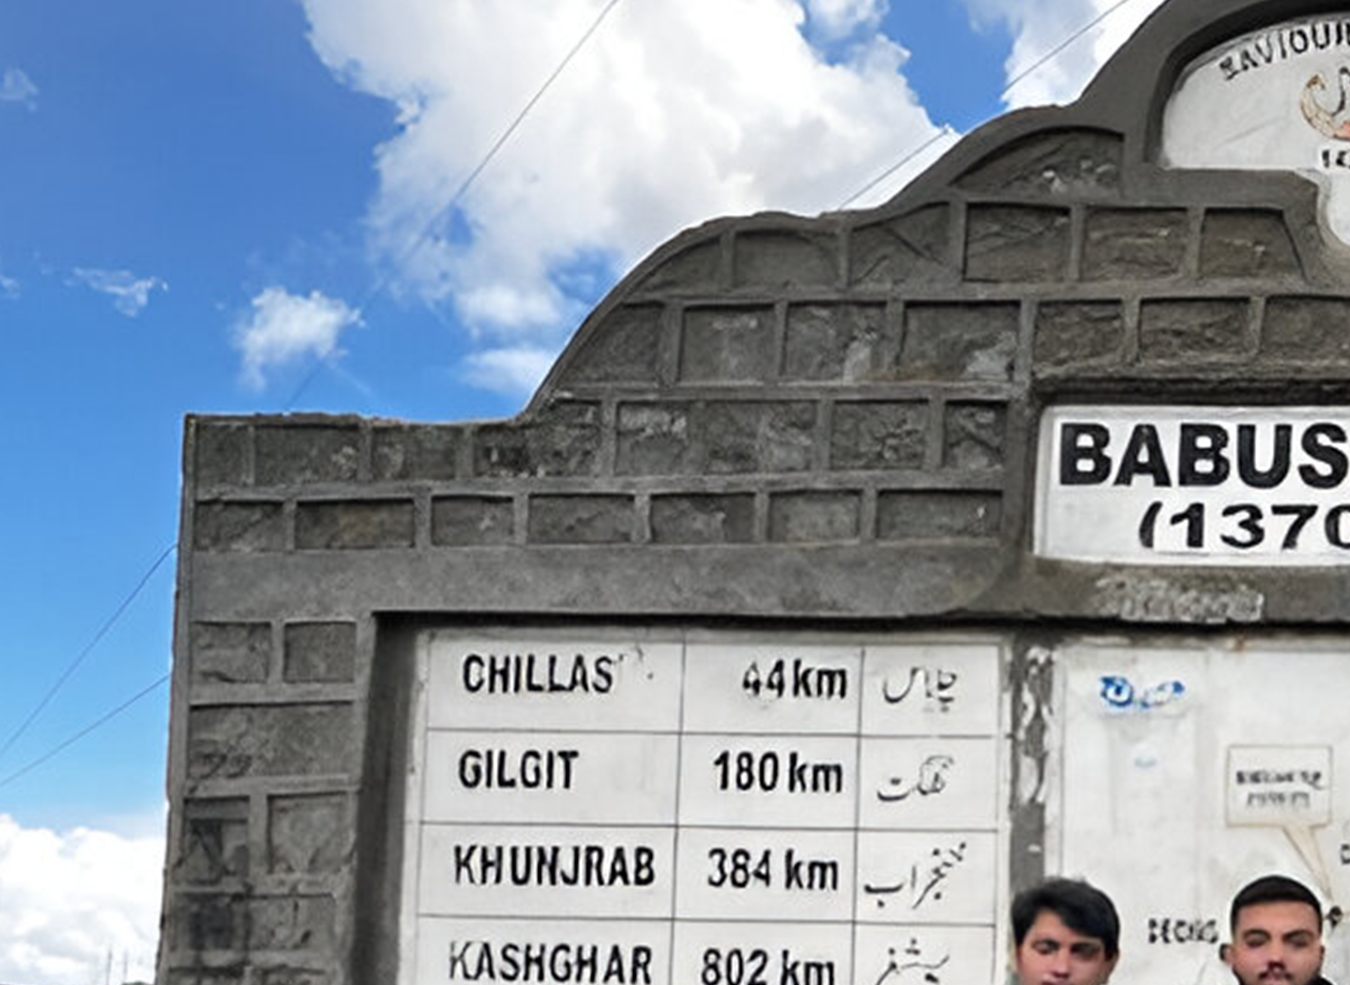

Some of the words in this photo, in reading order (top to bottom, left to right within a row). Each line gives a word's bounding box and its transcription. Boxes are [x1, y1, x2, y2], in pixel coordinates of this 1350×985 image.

[462, 654, 614, 694] CHILLAS
[458, 748, 580, 790] GILGIT
[452, 844, 656, 887] KHUNJRAB
[707, 847, 772, 889] 384
[784, 848, 839, 891] km
[448, 940, 653, 985] KASHGHAR
